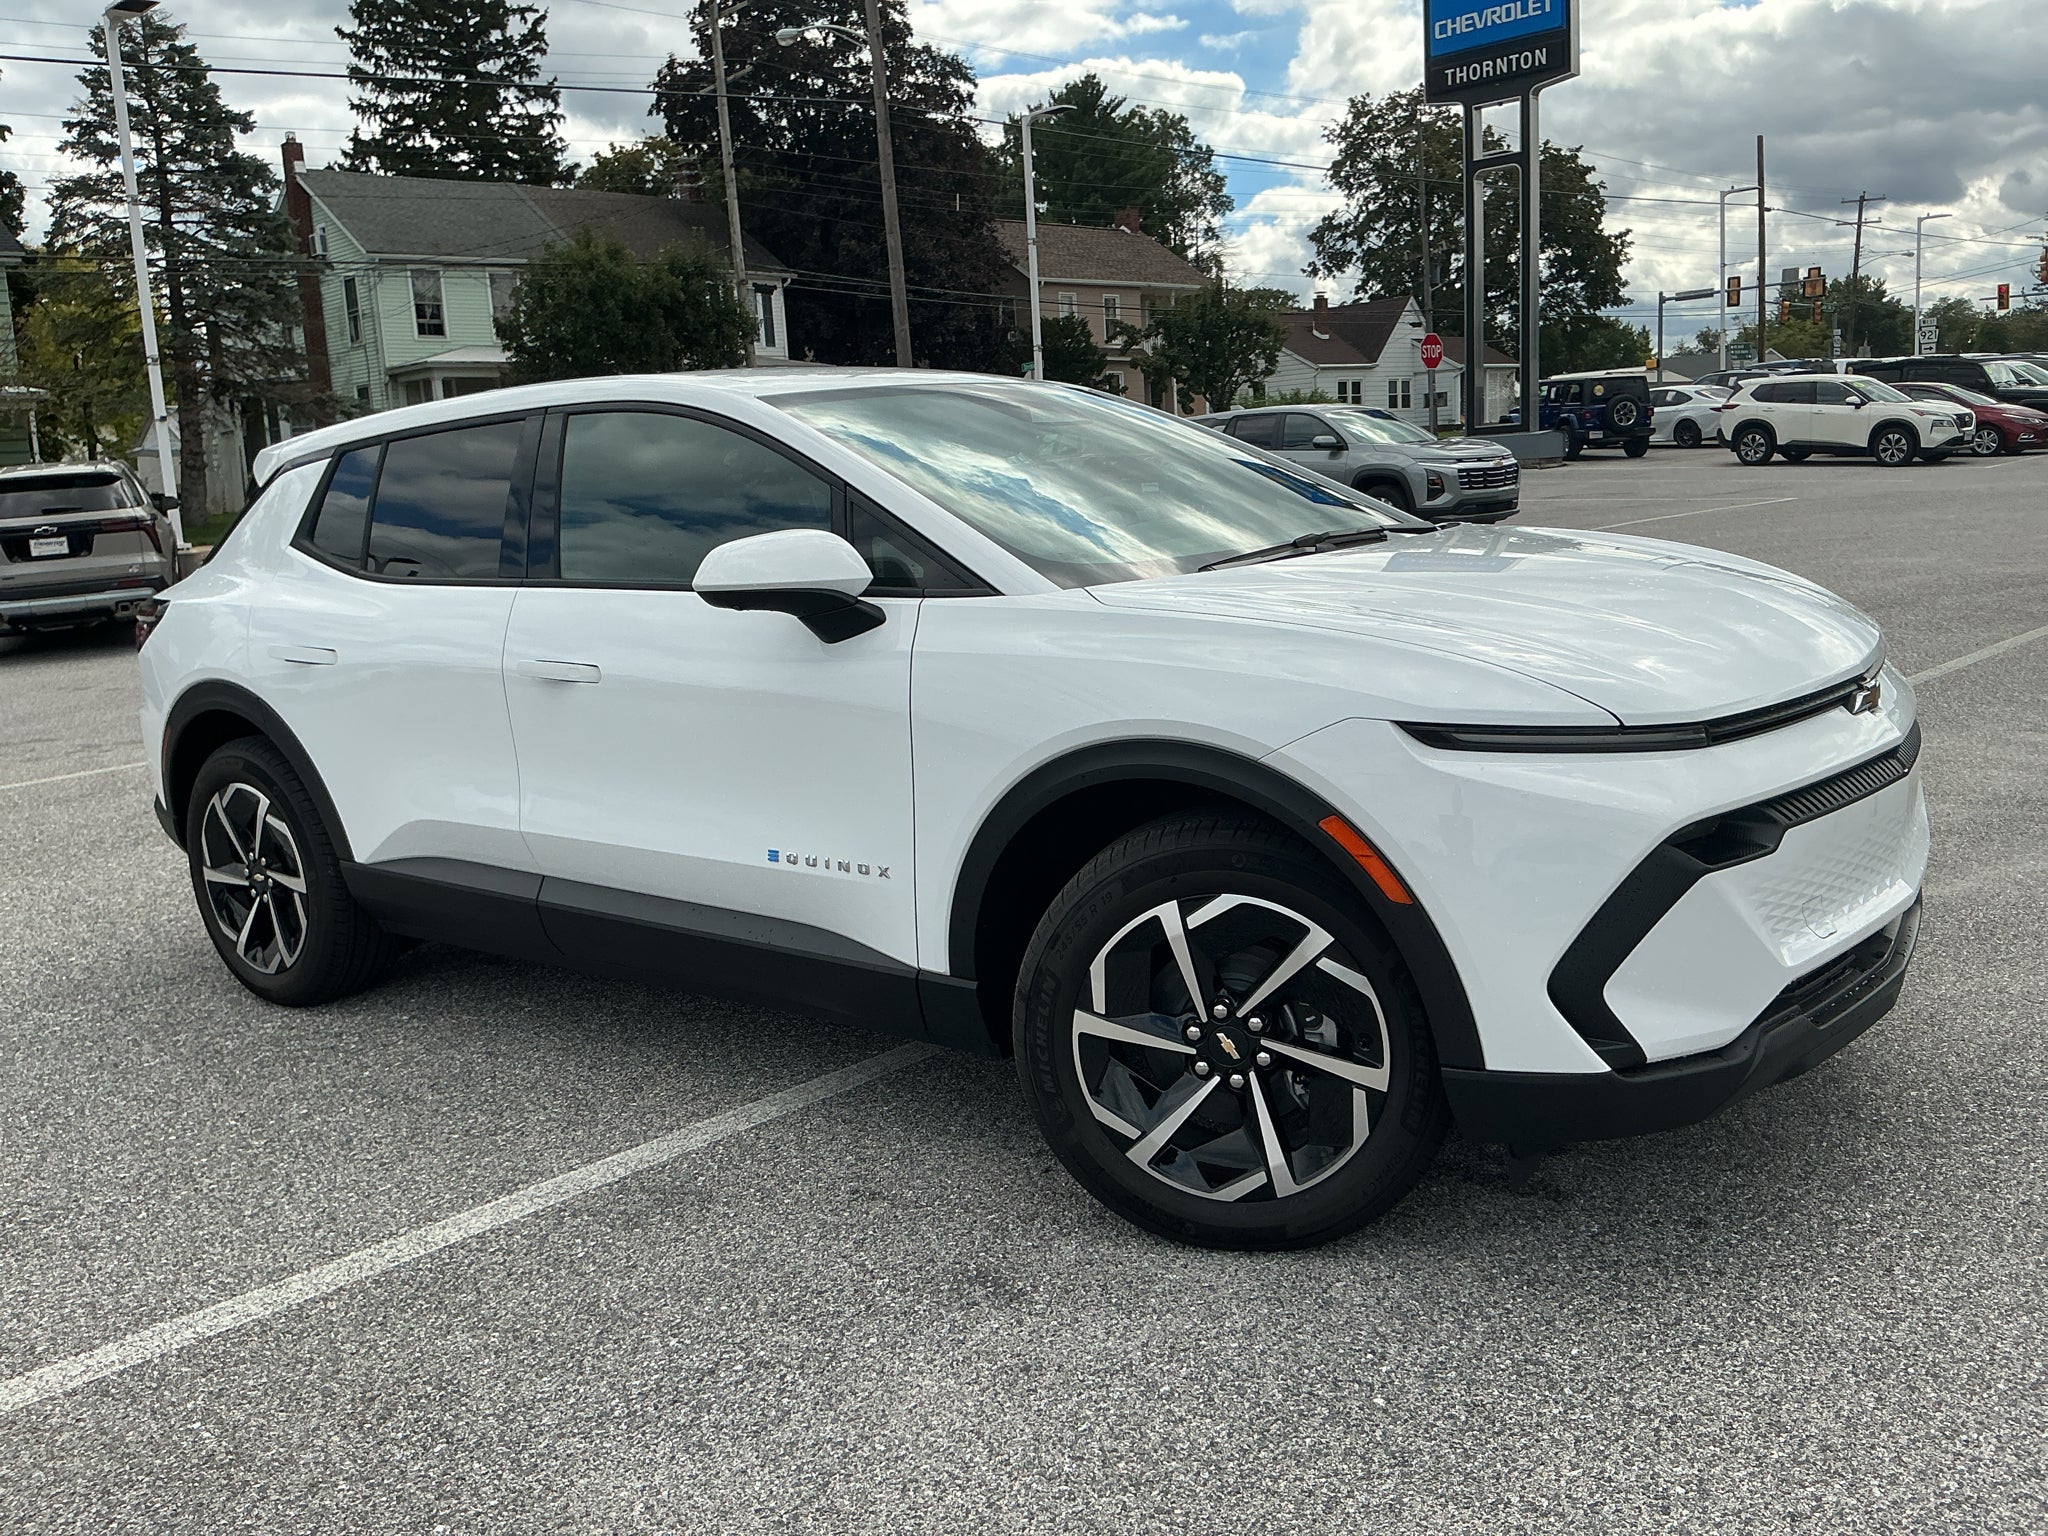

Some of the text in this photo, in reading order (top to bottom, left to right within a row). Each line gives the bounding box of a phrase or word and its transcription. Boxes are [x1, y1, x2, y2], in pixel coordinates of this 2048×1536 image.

[1434, 0, 1551, 40] CHEVROLET
[1444, 47, 1548, 86] THORNTON
[1421, 344, 1441, 358] STOP
[1920, 329, 1937, 340] 921
[767, 848, 891, 879] EQUINOX
[1036, 976, 1058, 1095] MICHELIN
